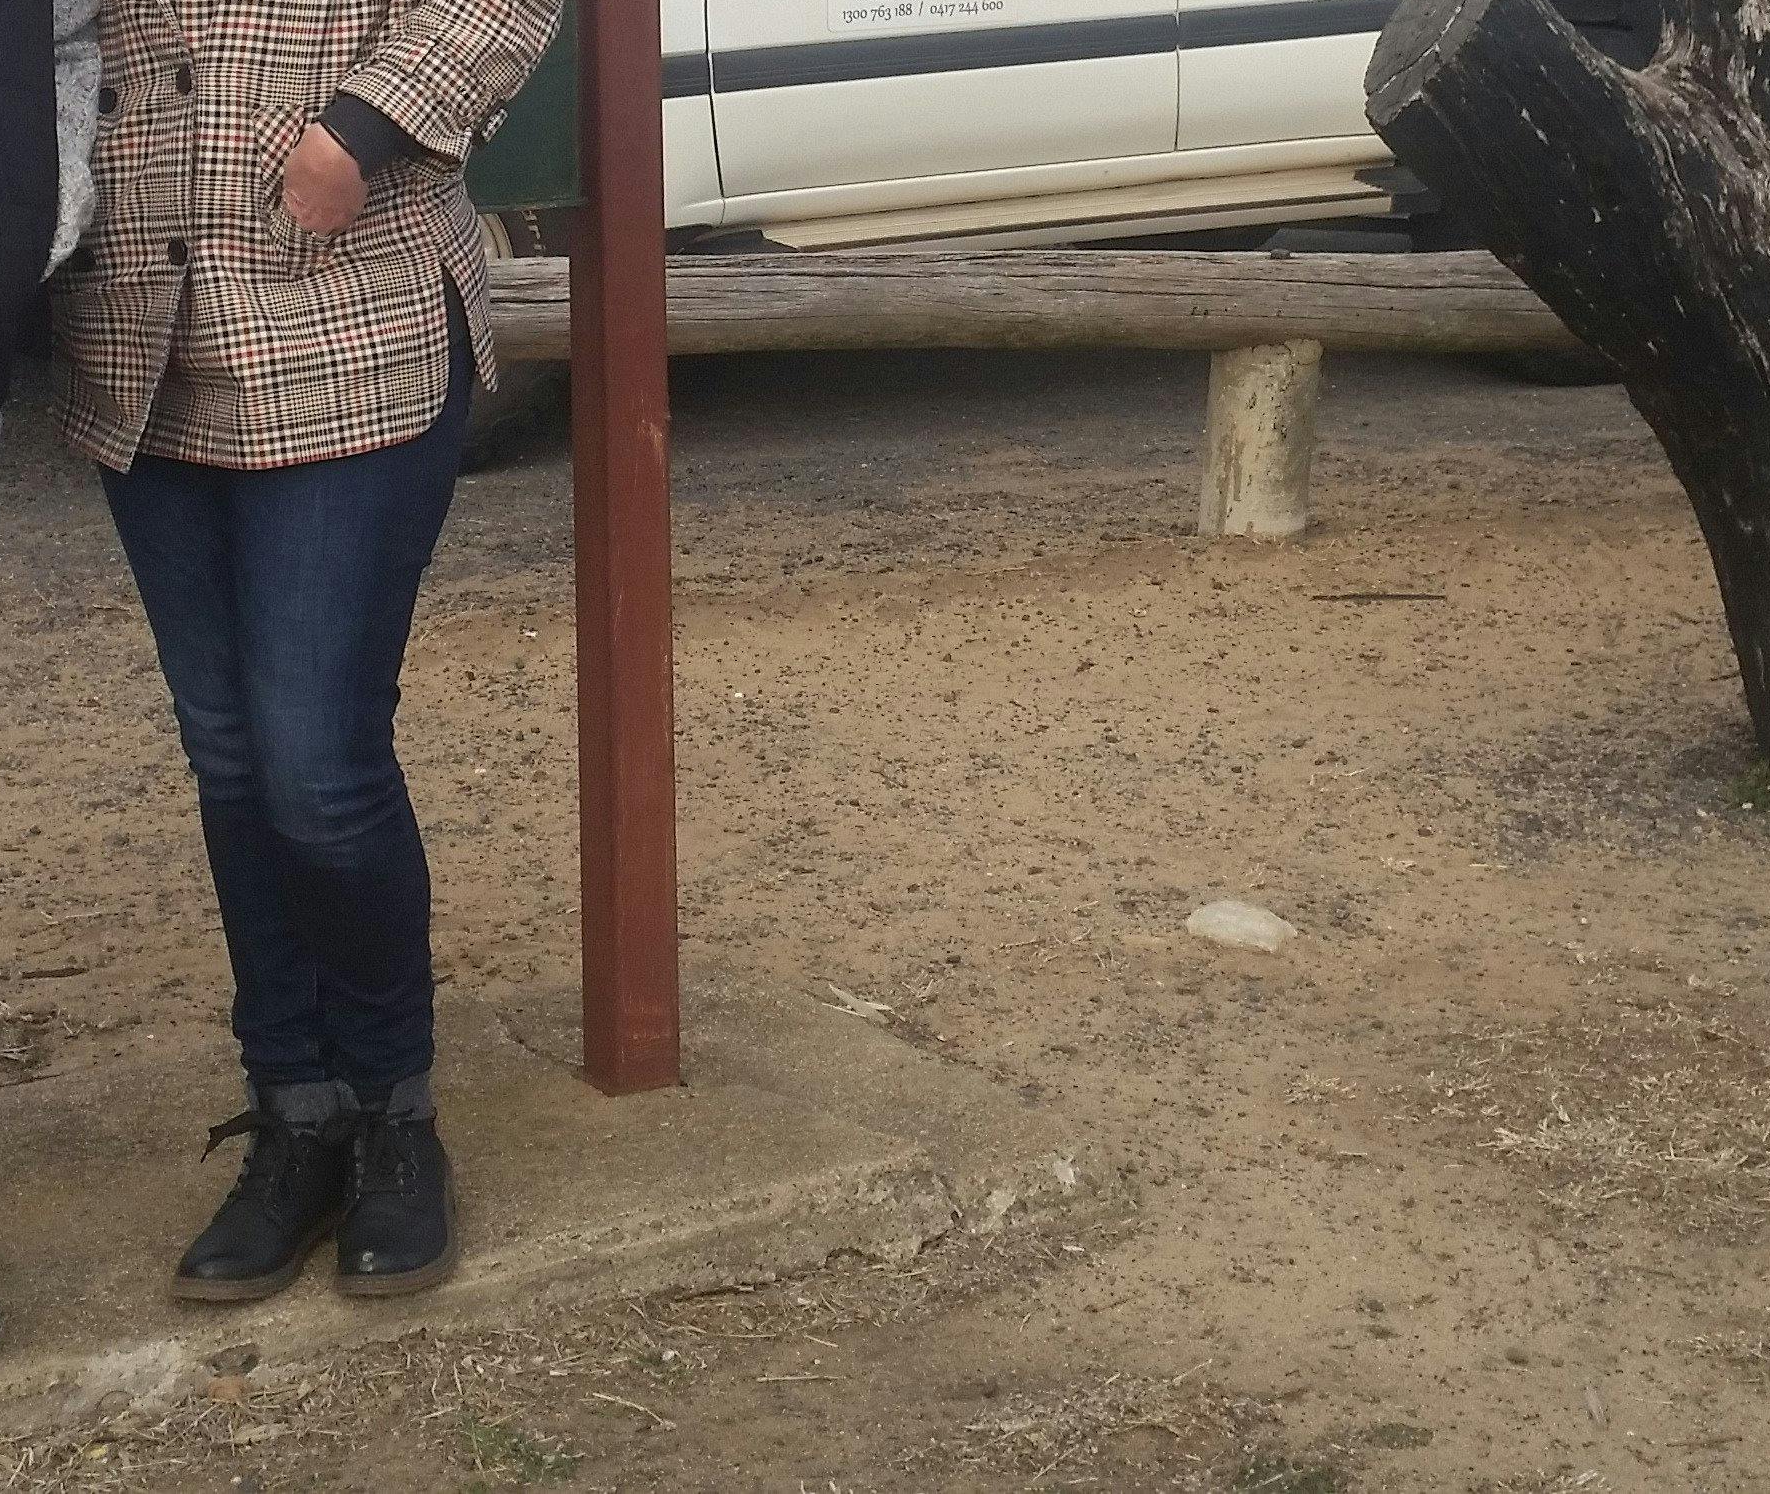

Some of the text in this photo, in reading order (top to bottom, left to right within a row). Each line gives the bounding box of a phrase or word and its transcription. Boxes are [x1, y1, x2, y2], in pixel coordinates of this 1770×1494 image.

[842, 8, 868, 24] 1300
[870, 5, 892, 22] 763
[894, 3, 913, 17] 188
[930, 3, 956, 17] 0417
[958, 1, 979, 15] 244
